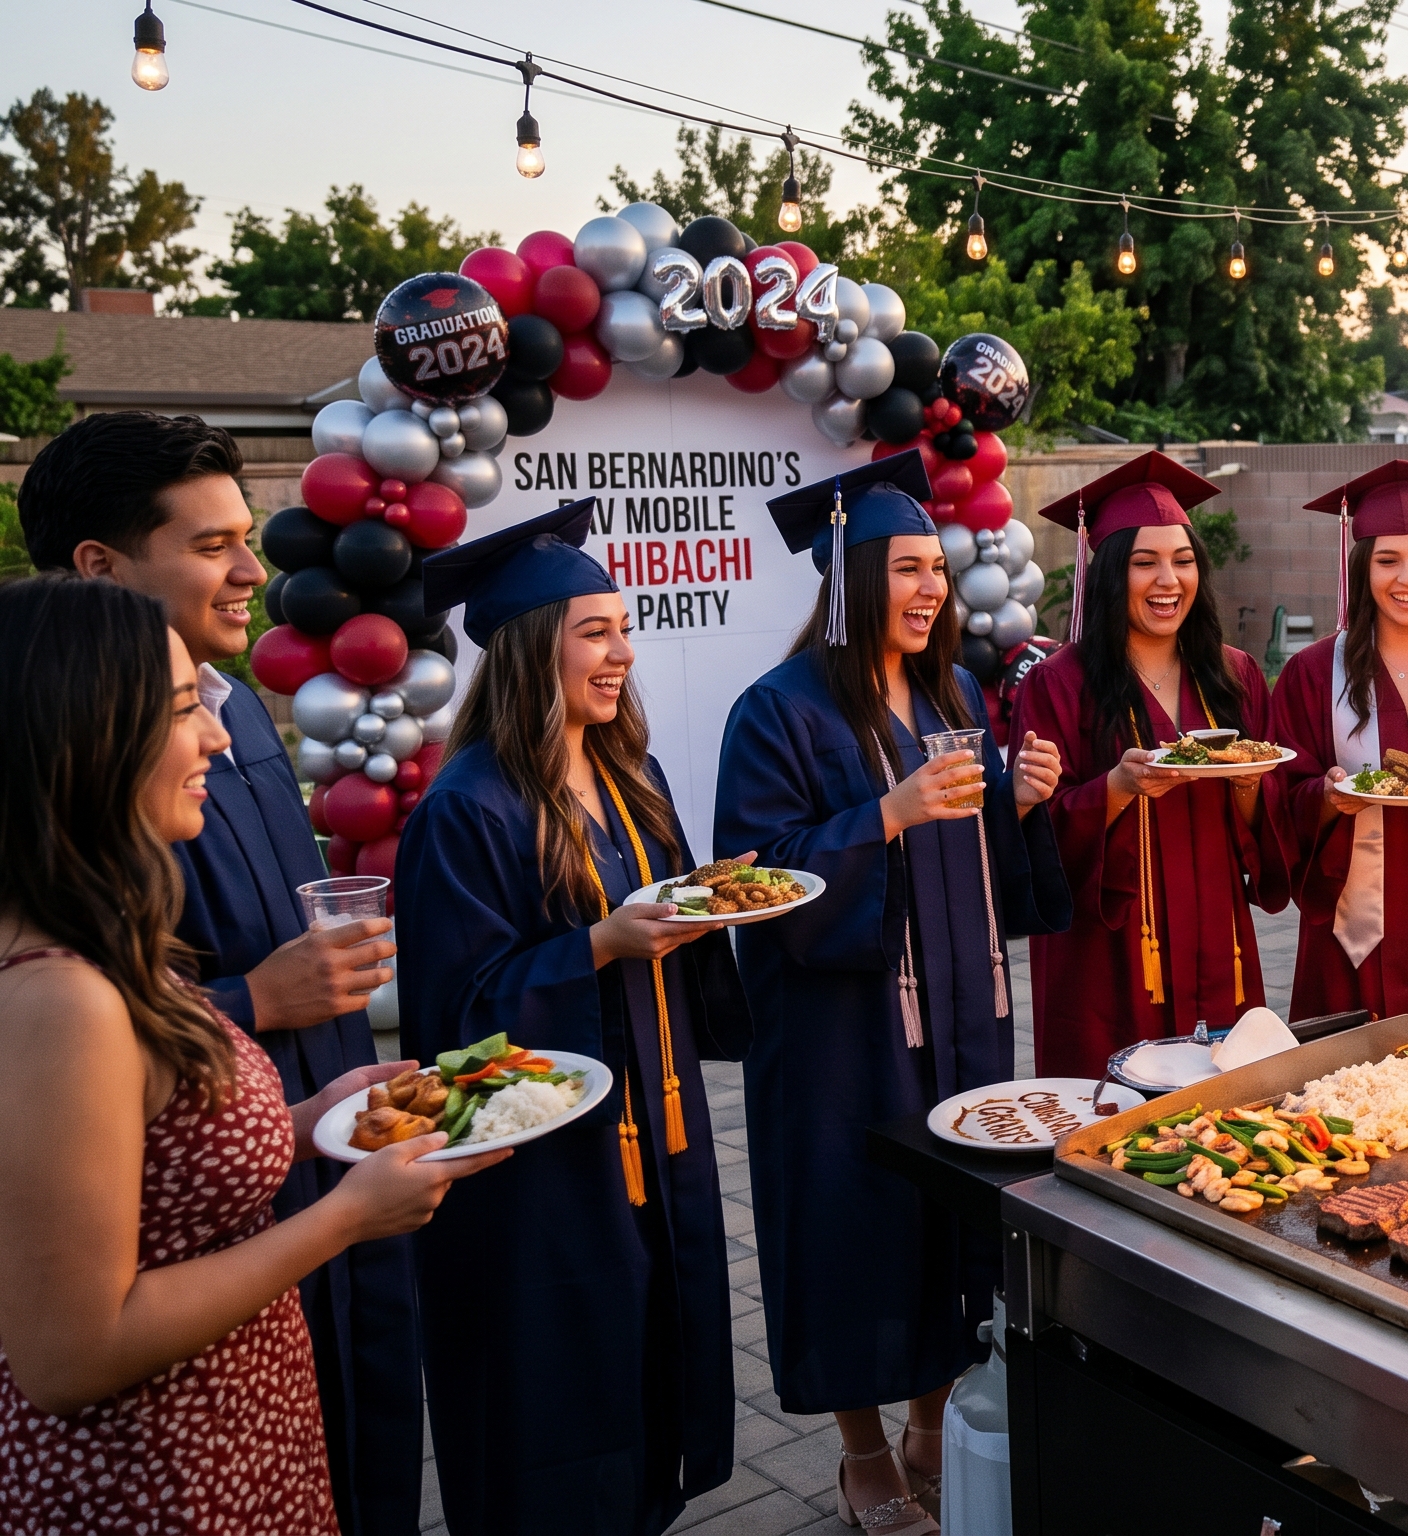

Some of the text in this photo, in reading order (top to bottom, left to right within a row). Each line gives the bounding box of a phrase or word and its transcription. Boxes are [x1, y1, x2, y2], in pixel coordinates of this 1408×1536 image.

[653, 254, 839, 343] 2024
[394, 305, 500, 345] GRADUATION
[409, 327, 506, 381] 2024
[514, 451, 801, 490] SAN BERNARDINO'S
[625, 495, 736, 534] MOBILE
[607, 537, 752, 587] HIBACHI
[637, 590, 730, 631] PARTY
